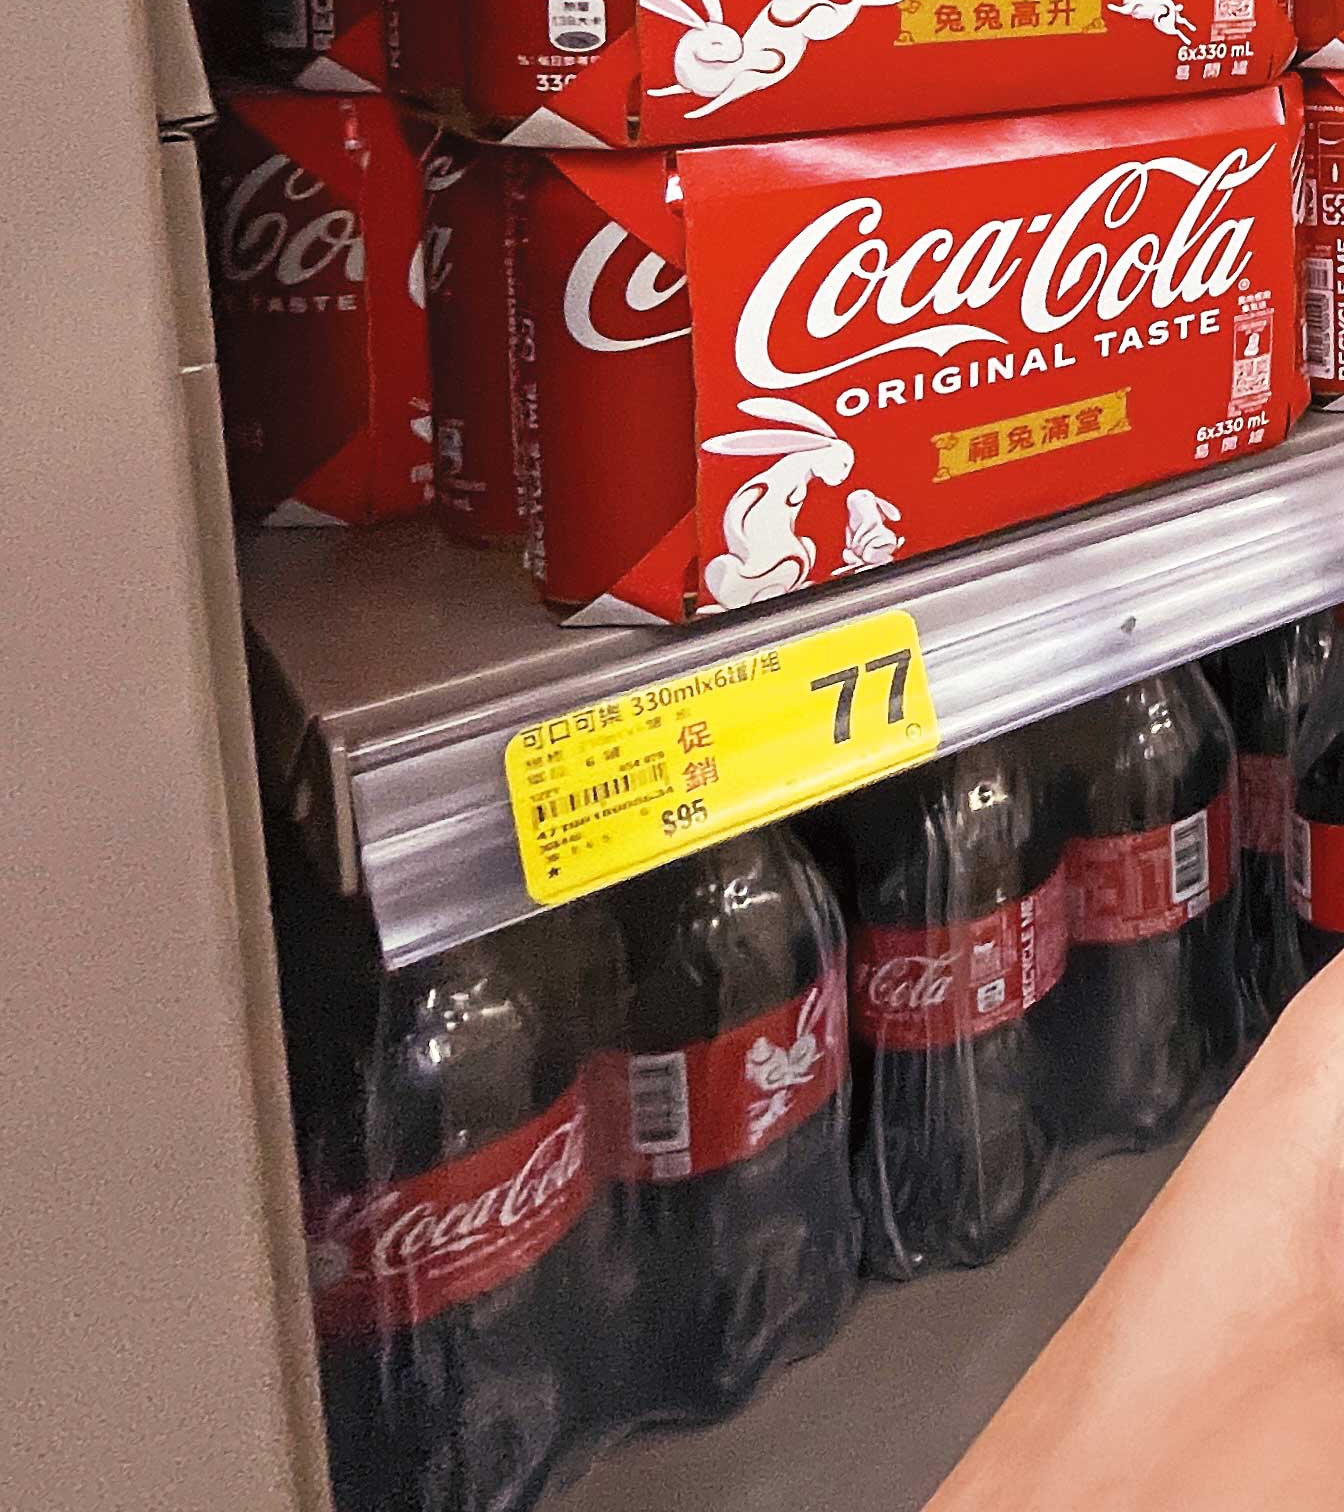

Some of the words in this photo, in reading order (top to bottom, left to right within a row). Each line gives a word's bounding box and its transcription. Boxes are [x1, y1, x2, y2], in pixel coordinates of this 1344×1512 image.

[1177, 42, 1227, 62] 6x330
[1230, 40, 1255, 58] mL
[735, 143, 1277, 388] Coca-Cola
[835, 344, 1077, 418] ORIGINAL
[1096, 308, 1222, 359] TASTE
[1196, 417, 1244, 442] 6x330
[1247, 410, 1271, 429] mL
[810, 648, 912, 745] 77
[521, 702, 623, 750] 可口可樂
[661, 798, 709, 837] $95
